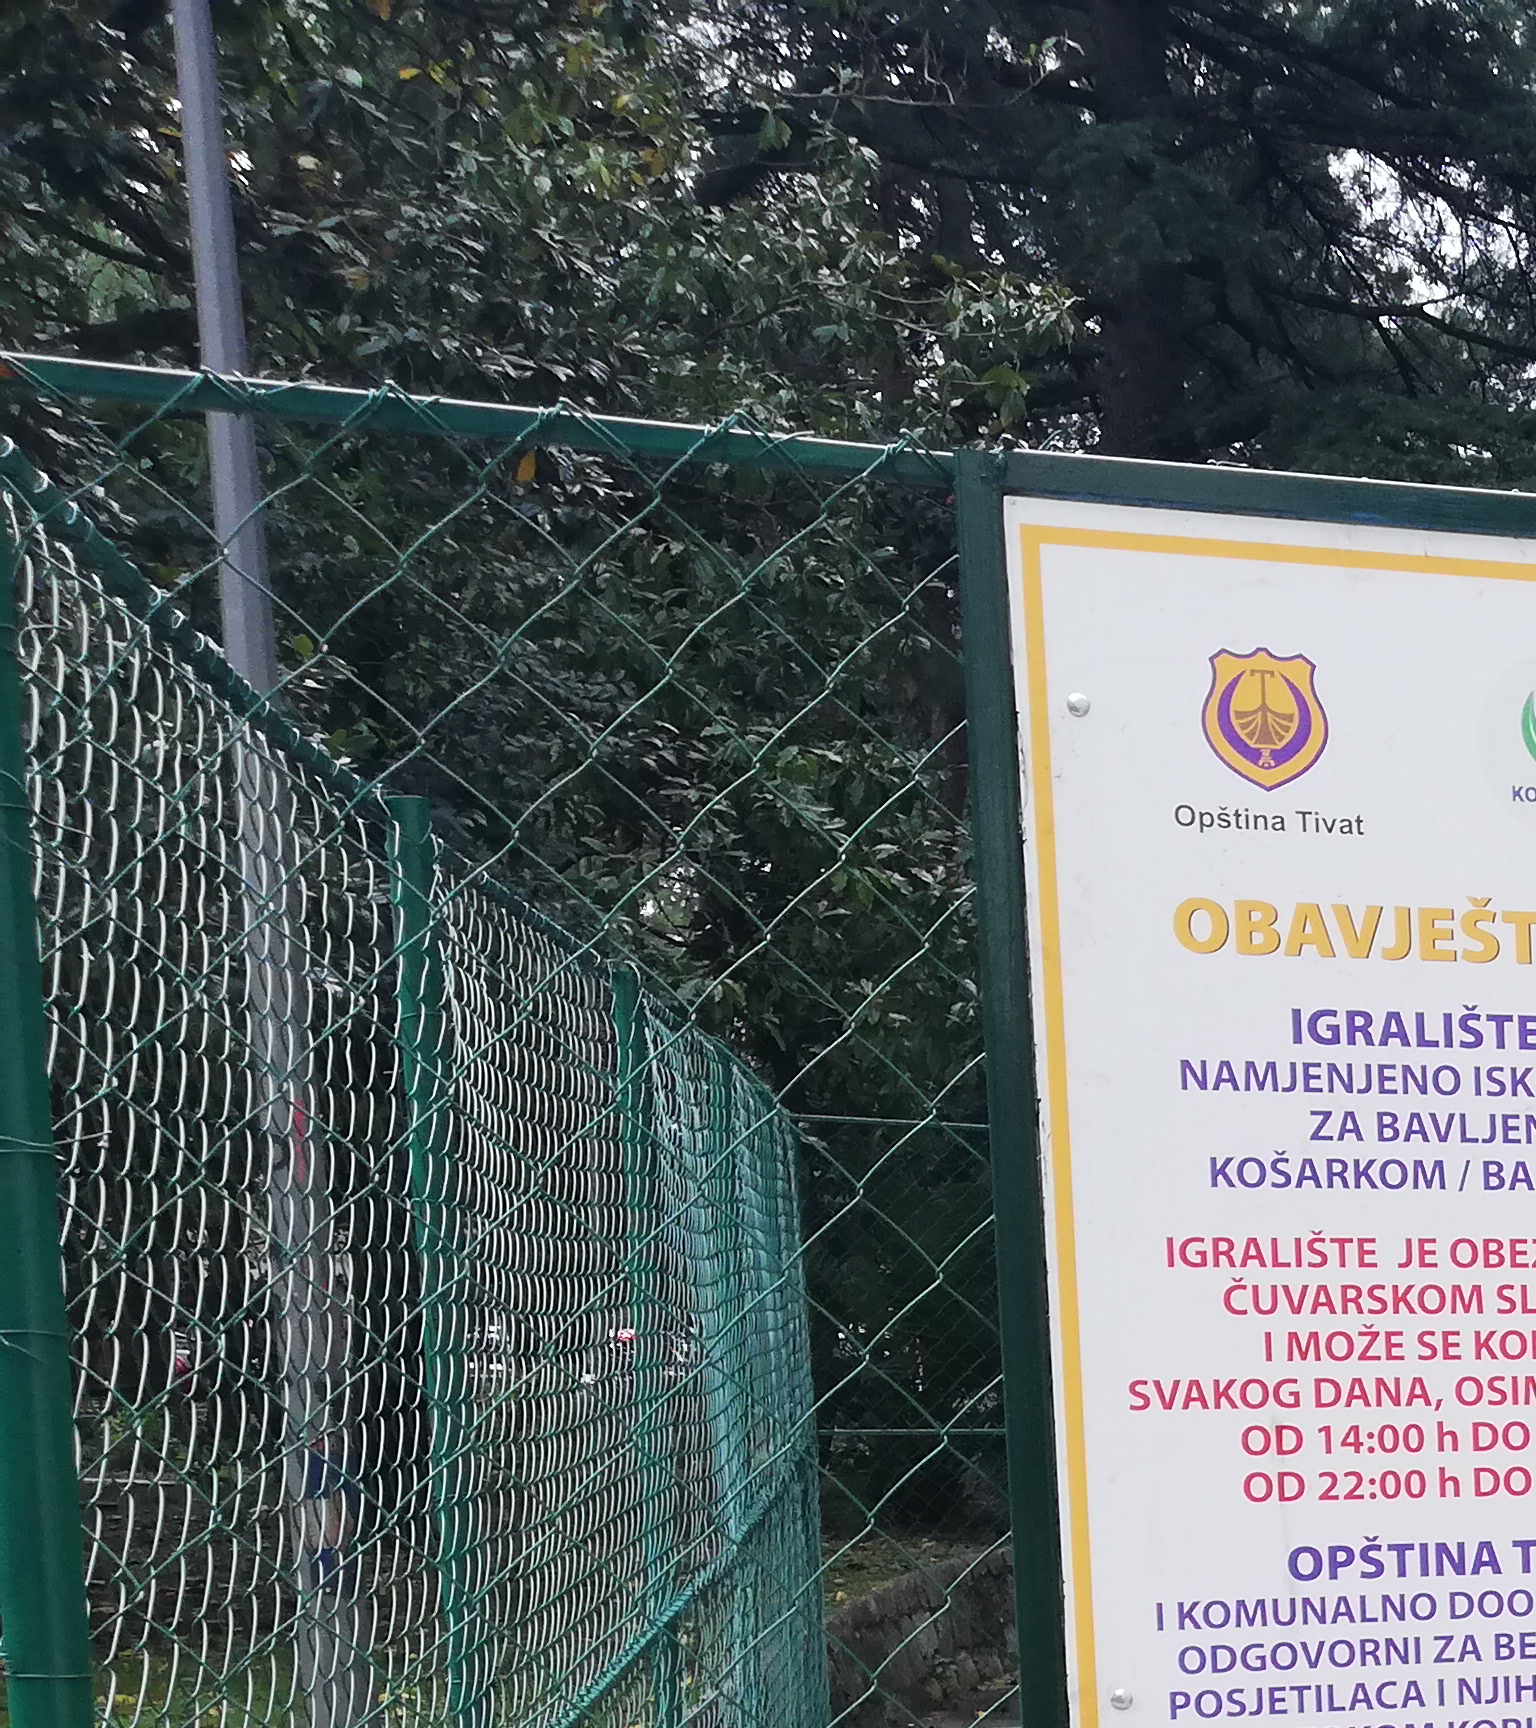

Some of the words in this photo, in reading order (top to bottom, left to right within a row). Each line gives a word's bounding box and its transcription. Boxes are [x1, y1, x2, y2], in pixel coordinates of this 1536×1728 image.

[1174, 804, 1286, 834] Opština
[1294, 810, 1365, 836] Tivat
[1179, 1059, 1461, 1096] NAMJENJENO
[1309, 1110, 1365, 1142] ZA
[1209, 1150, 1447, 1191] KOŠARKOM
[1458, 1159, 1471, 1192] /
[1166, 1229, 1379, 1269] IGRALIŠTE
[1397, 1237, 1439, 1269] JE
[1223, 1276, 1484, 1316] ČUVARSKOM
[1263, 1331, 1274, 1362] I
[1286, 1323, 1406, 1362] MOŽE
[1417, 1330, 1463, 1361] SE
[1128, 1377, 1301, 1412] SVAKOG
[1313, 1376, 1444, 1412] DANA,
[1241, 1424, 1304, 1457] OD
[1317, 1423, 1425, 1455] 14:00
[1436, 1420, 1459, 1453] h
[1471, 1420, 1531, 1452] DO
[1243, 1471, 1306, 1503] OD
[1318, 1469, 1427, 1501] 22:00
[1438, 1466, 1461, 1498] h
[1473, 1466, 1533, 1498] DO
[1287, 1535, 1503, 1582] OPŠTINA
[1154, 1602, 1165, 1632] I
[1177, 1592, 1437, 1631] KOMUNALNO
[1449, 1589, 1534, 1620] DOO
[1178, 1636, 1422, 1675] ODGOVORNI
[1432, 1634, 1483, 1664] ZA
[1169, 1679, 1426, 1721] POSJETILACA
[1436, 1678, 1446, 1707] I
